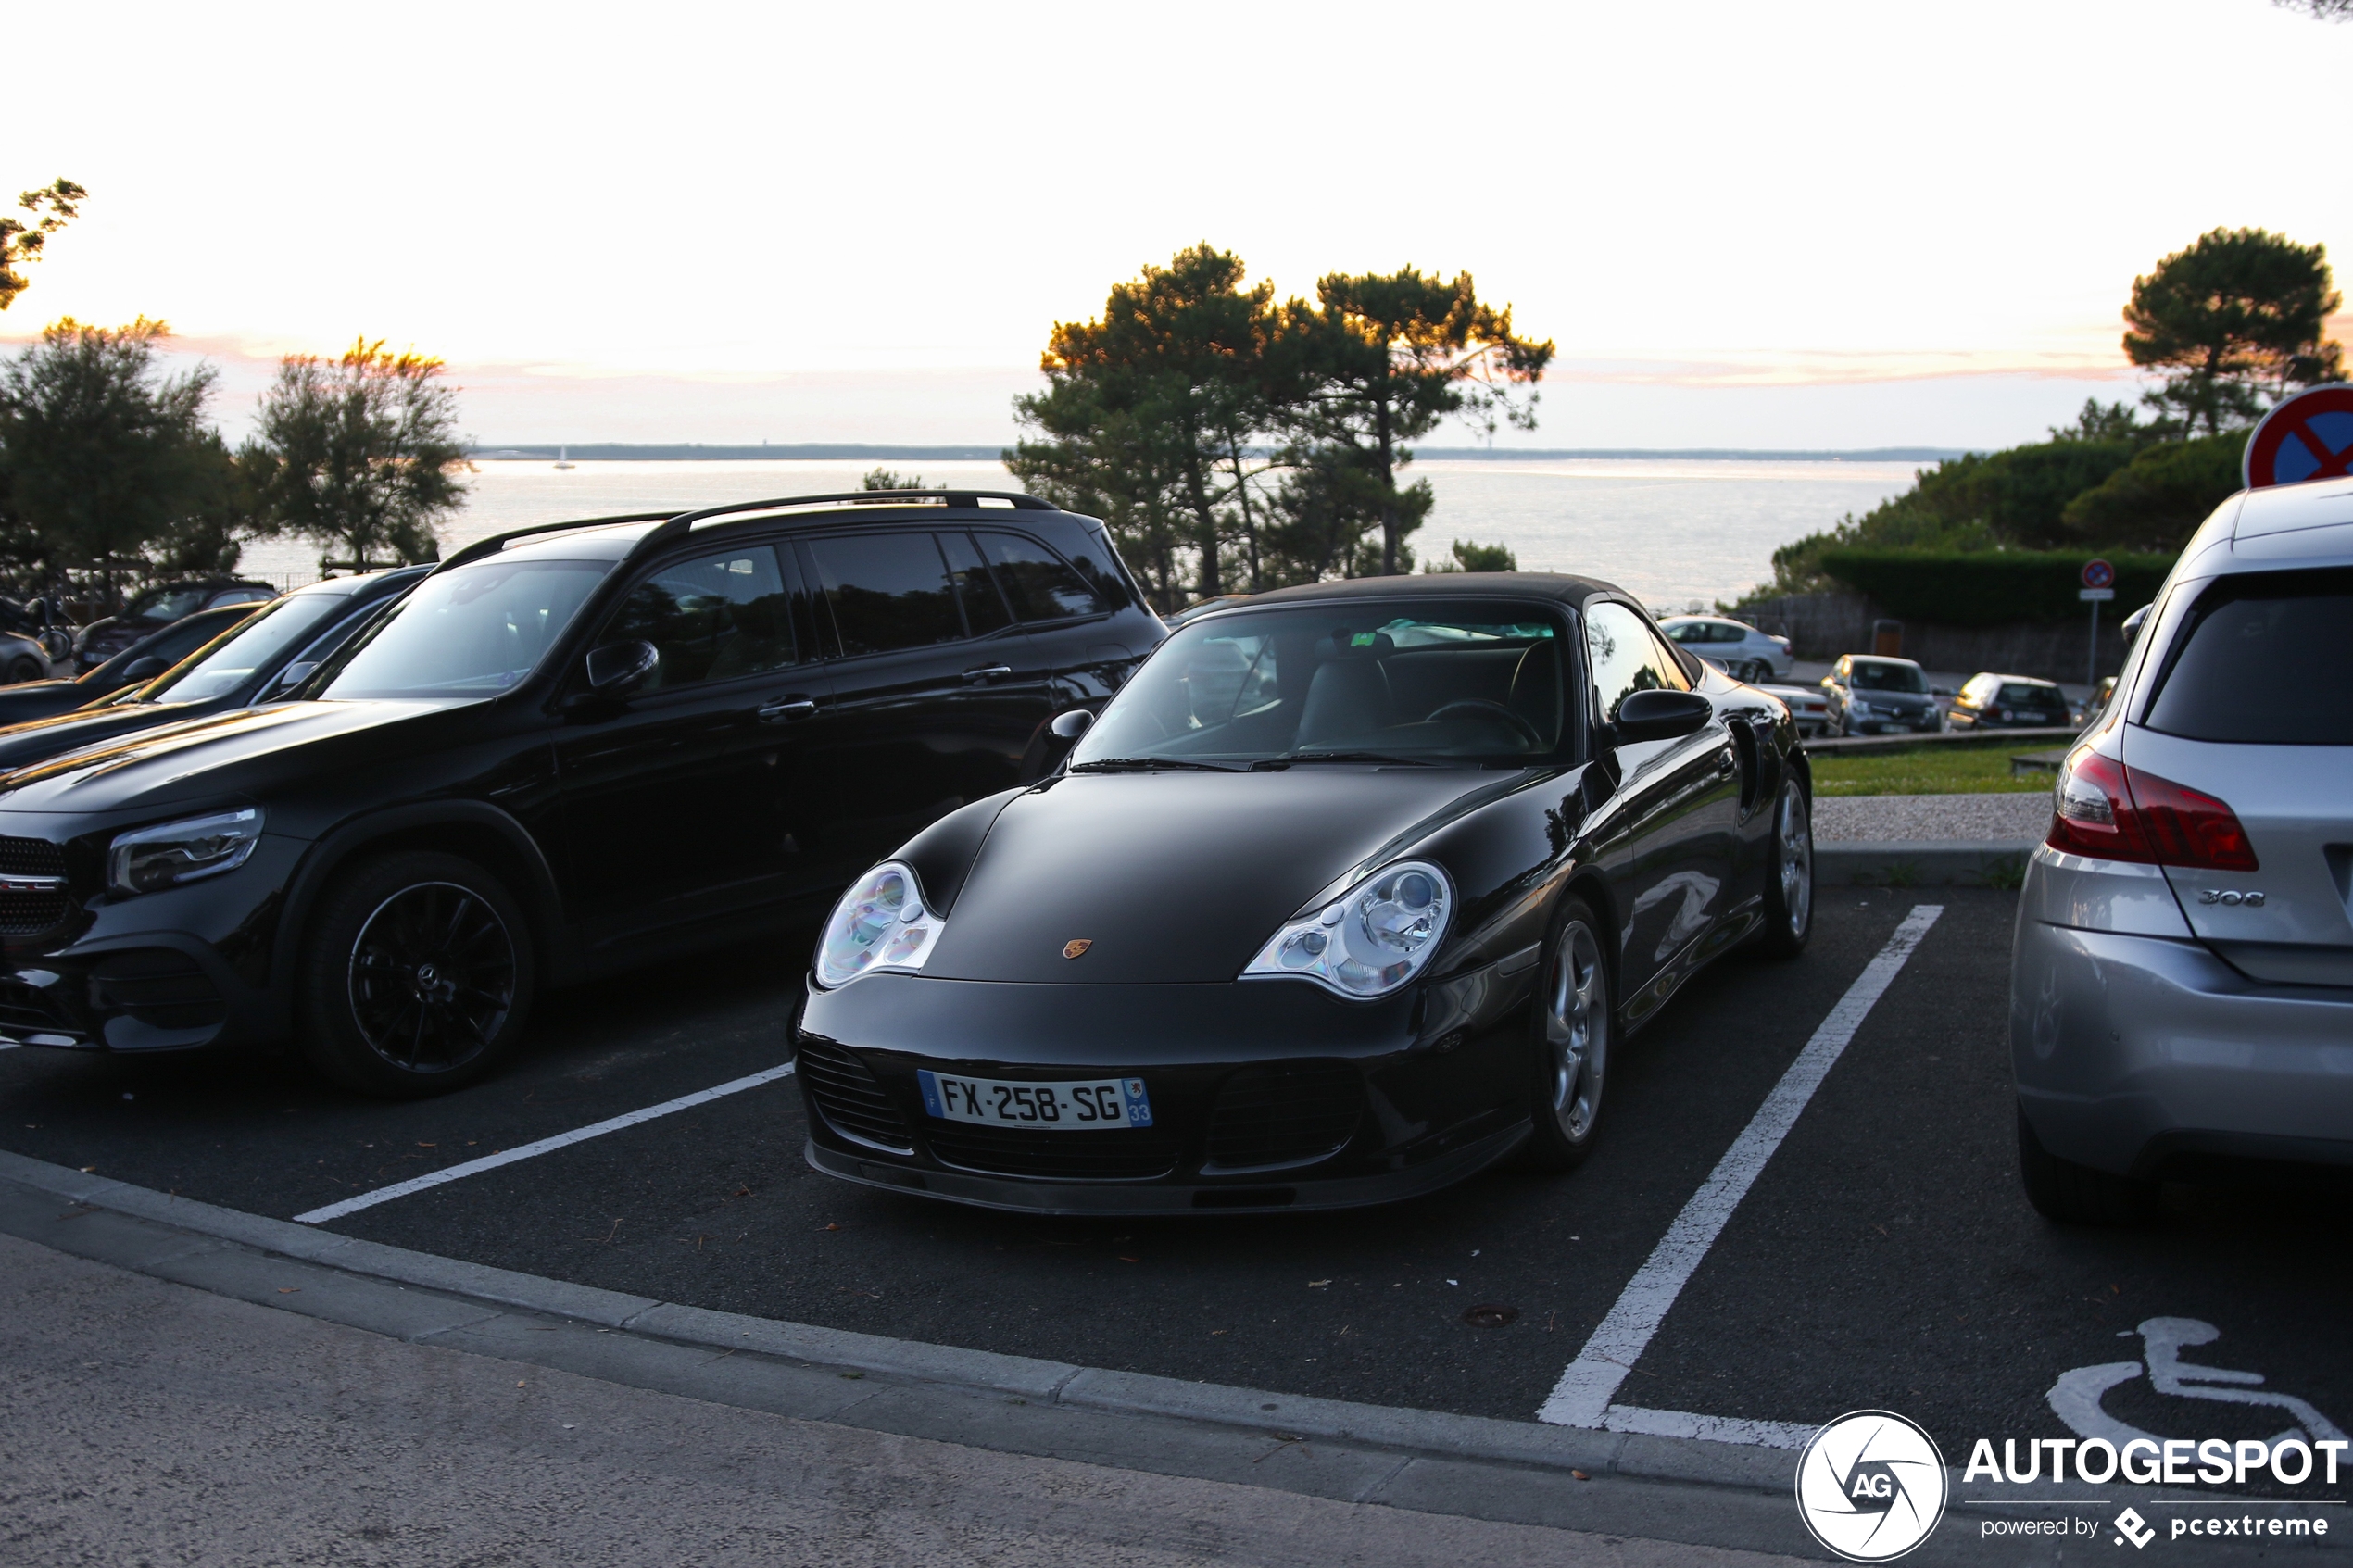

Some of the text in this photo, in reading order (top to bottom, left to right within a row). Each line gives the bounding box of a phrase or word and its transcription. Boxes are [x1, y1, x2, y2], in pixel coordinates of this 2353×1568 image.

[2198, 889, 2266, 907] 308
[941, 1079, 1121, 1121] FX-258-SG
[1128, 1104, 1151, 1121] 33
